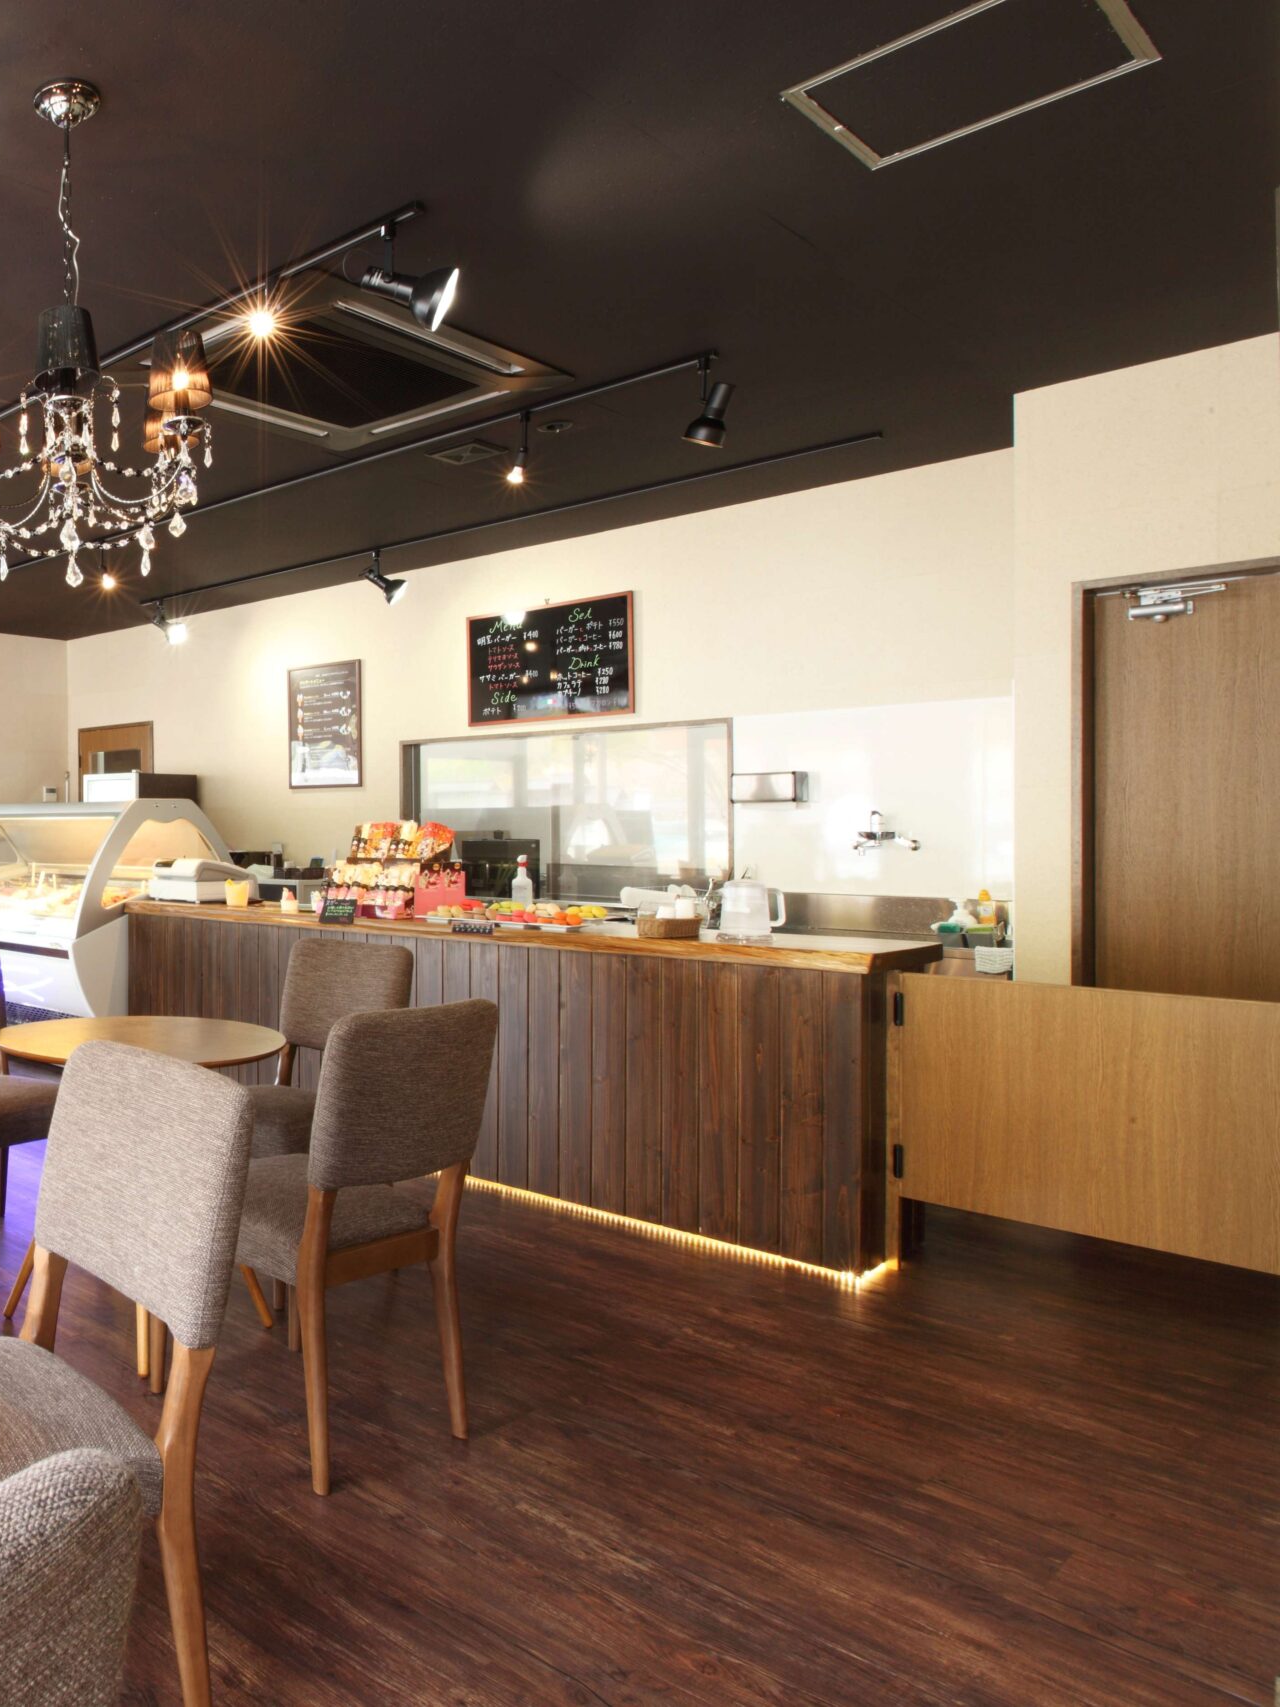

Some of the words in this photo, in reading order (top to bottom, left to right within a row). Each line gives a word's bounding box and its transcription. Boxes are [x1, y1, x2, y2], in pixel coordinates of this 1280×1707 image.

[568, 607, 593, 623] Set
[488, 620, 522, 634] Menu
[568, 654, 600, 670] Drink
[491, 690, 518, 705] Side
